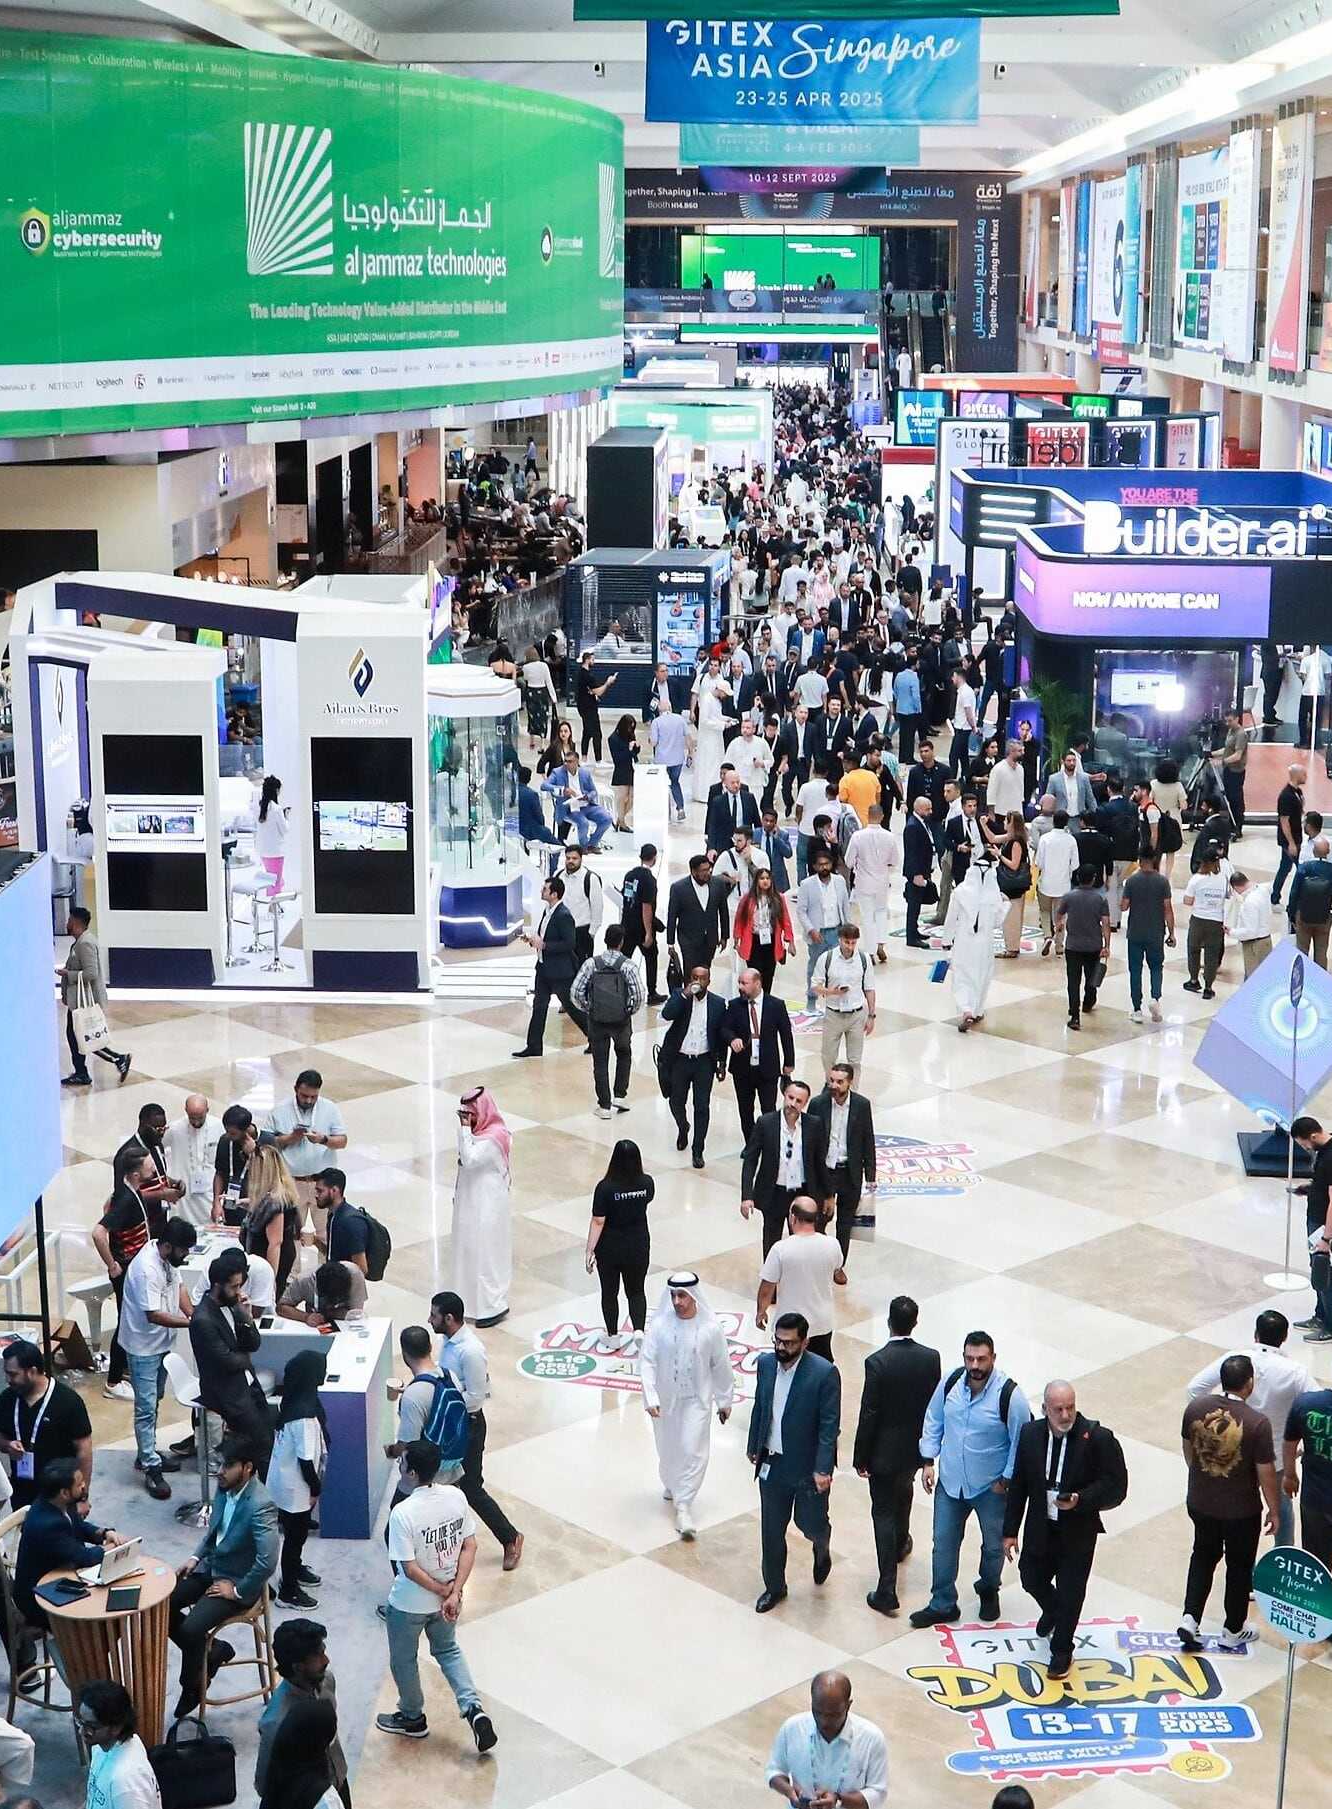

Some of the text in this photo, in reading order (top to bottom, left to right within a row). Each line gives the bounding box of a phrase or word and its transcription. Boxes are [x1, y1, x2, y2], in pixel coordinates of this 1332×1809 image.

[666, 20, 773, 46] GITEX
[778, 23, 961, 79] Singapore
[88, 53, 189, 73] Collaboration Wireless
[691, 53, 772, 78] ASIA
[735, 91, 883, 107] 23-25 APR 2025
[748, 173, 837, 183] 10-12 SEPT 2025
[52, 210, 122, 229] aljammaz
[53, 229, 162, 250] cybersecurity
[361, 247, 507, 284] jammaz technologies
[270, 302, 362, 320] Leading Technology
[1035, 427, 1079, 438] GITEX
[1084, 500, 1307, 556] Builder.ai
[1073, 591, 1219, 609] NOW ANYONE CAN
[323, 702, 399, 714] Ajlan Bros
[534, 1353, 587, 1366] 14-16
[426, 1529, 437, 1544] LET
[435, 1539, 447, 1553] YOU
[1274, 1556, 1323, 1584] GITEX
[1270, 1612, 1304, 1634] HALL
[907, 1654, 1218, 1710] DUBAI
[1023, 1708, 1138, 1735] 13-17
